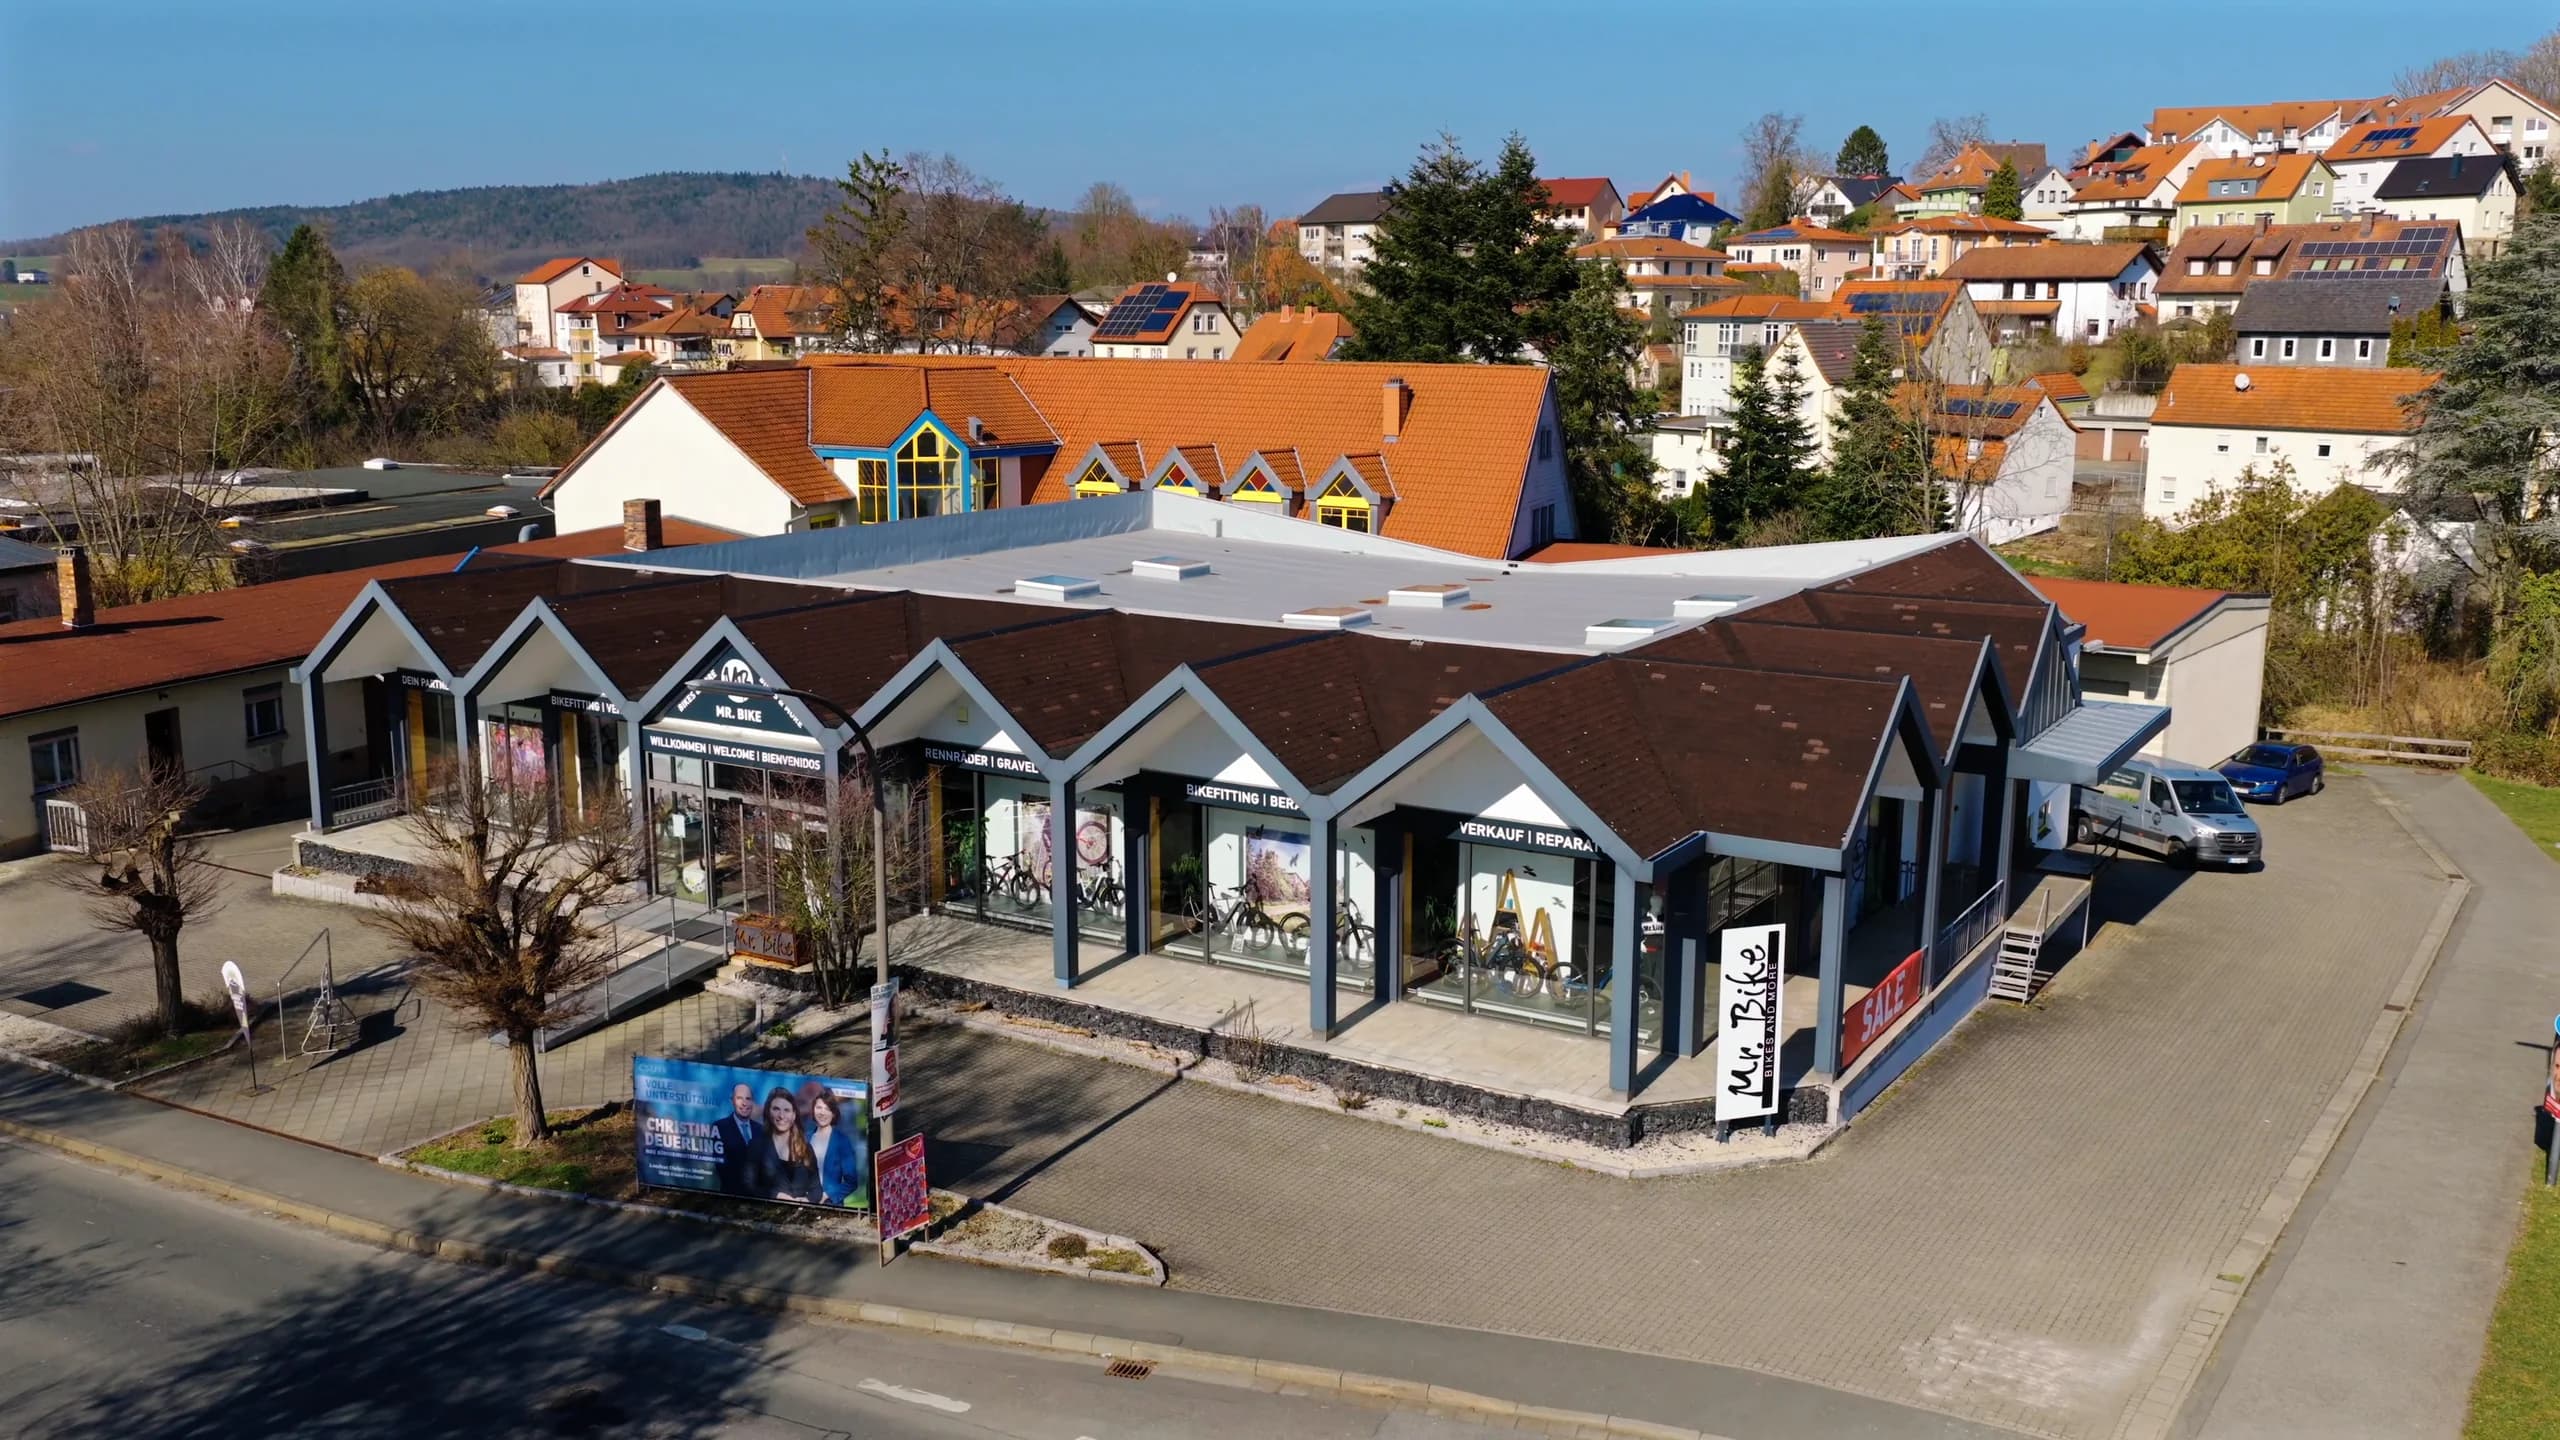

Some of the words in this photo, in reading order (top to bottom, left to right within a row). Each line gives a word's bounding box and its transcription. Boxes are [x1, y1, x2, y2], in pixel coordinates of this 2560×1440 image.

[401, 675, 419, 686] DEIN
[551, 695, 601, 712] BIKEFITTING
[715, 705, 735, 719] MR.
[737, 708, 762, 723] BIKE
[650, 736, 706, 754] WILLKOMMEN
[713, 745, 755, 761] WELCOME
[762, 752, 821, 771] BIENVENIDOS
[925, 747, 988, 767] RENNRÄDER
[997, 758, 1038, 774] GRAVEL
[1186, 783, 1259, 805] BIKEFITTING
[1459, 821, 1525, 841] VERKAUF
[1725, 944, 1768, 1029] Bike
[1768, 962, 1778, 1001] MORE
[1861, 969, 1906, 1043] SALE
[1766, 1007, 1777, 1033] AND
[1728, 1042, 1763, 1097] Mr.
[1764, 1037, 1776, 1078] BIKES
[646, 1080, 673, 1091] VOLLE
[646, 1117, 721, 1139] CHRISTINA
[645, 1132, 724, 1154] DEUERLING
